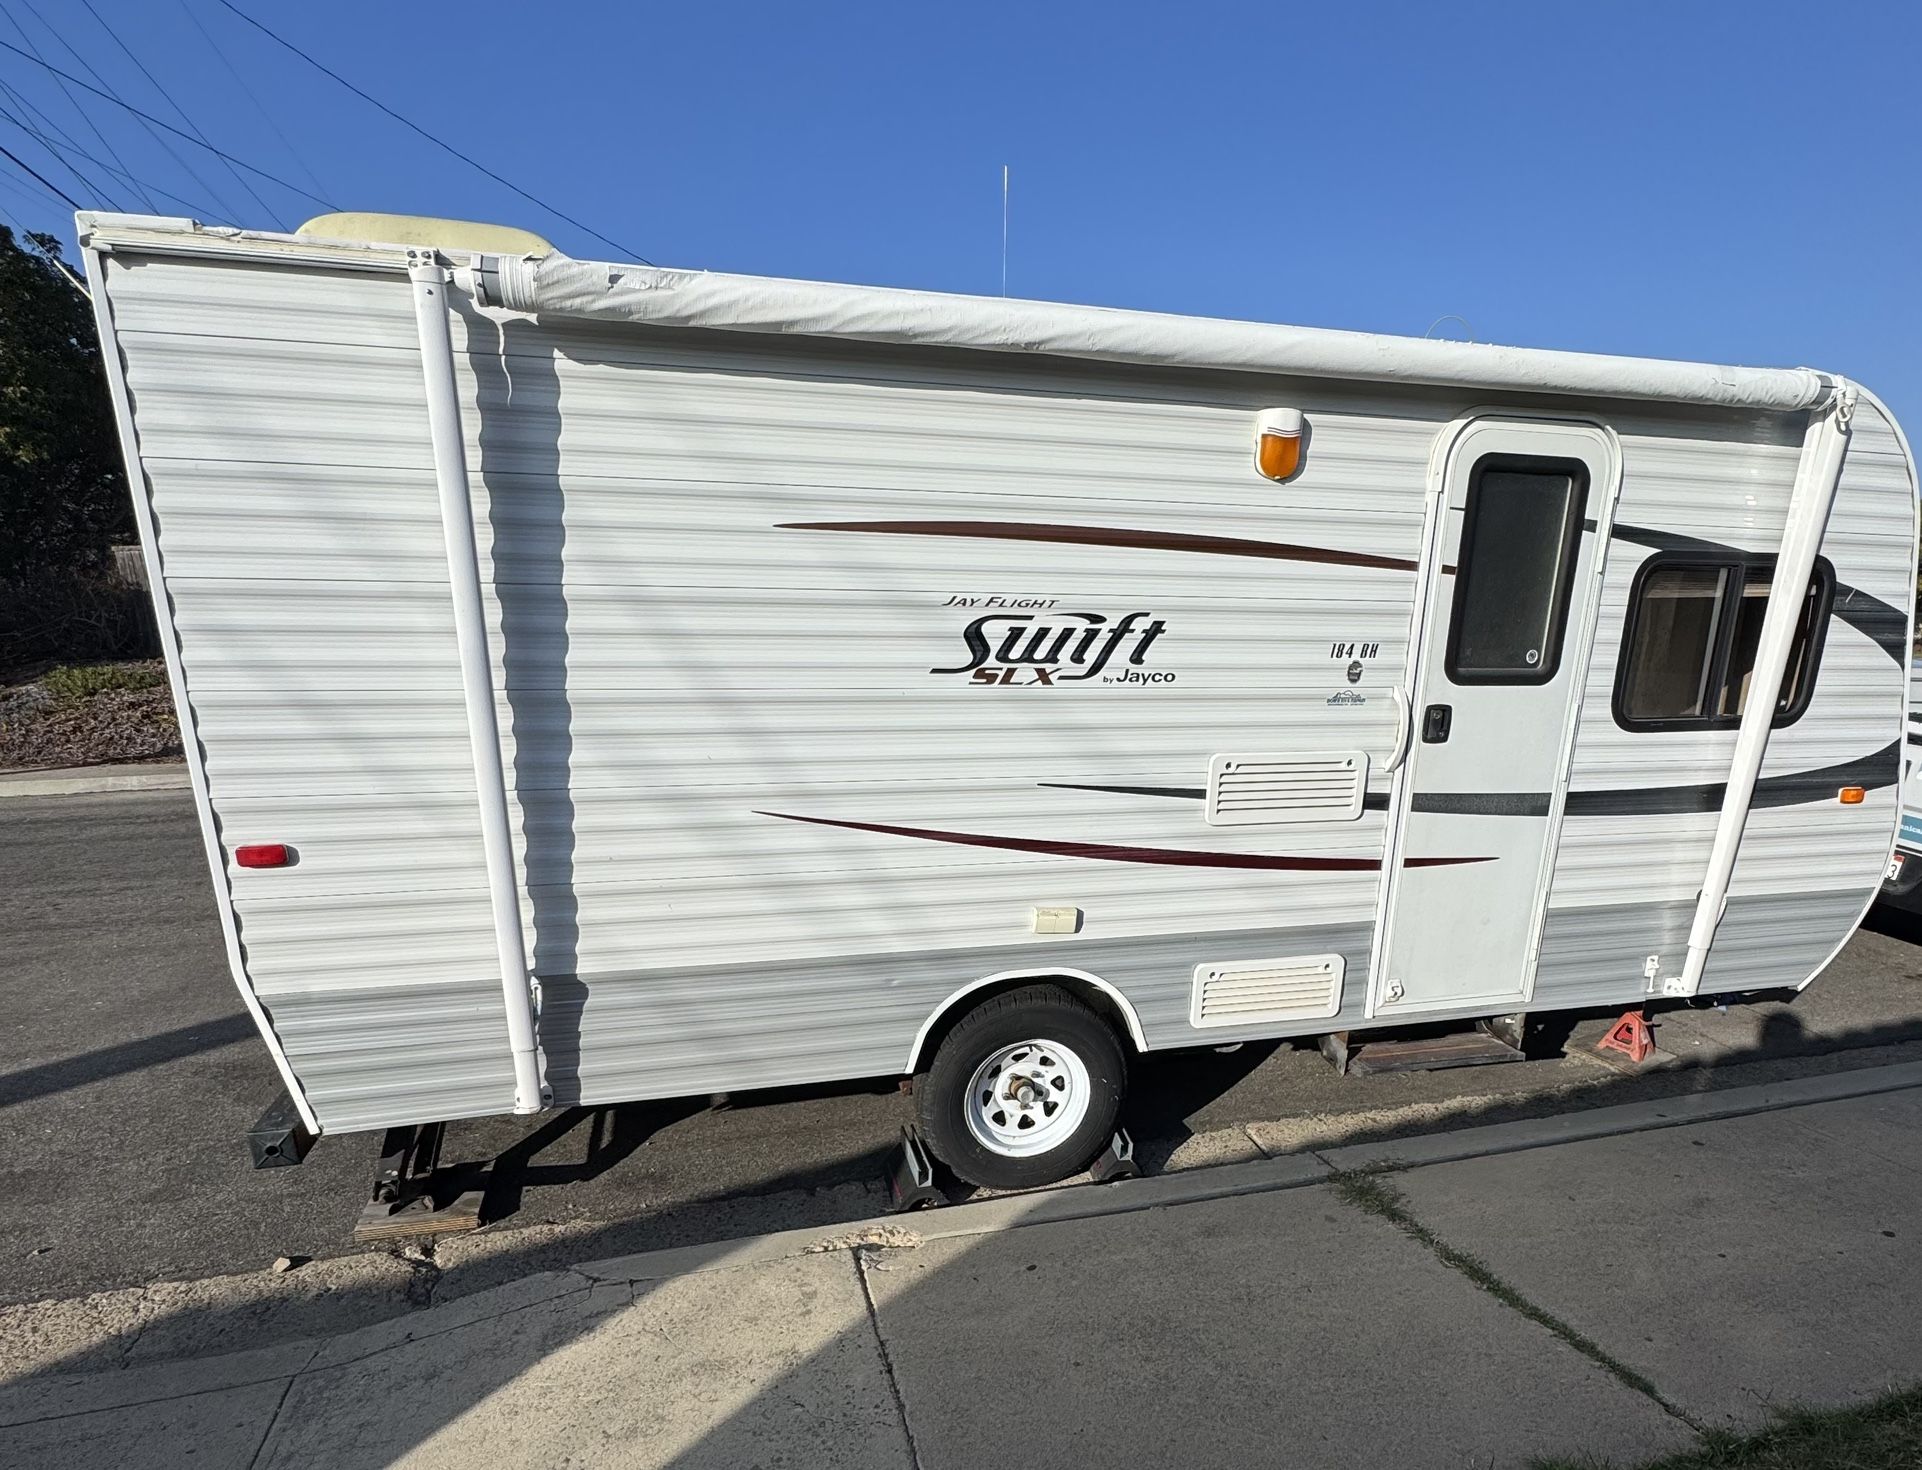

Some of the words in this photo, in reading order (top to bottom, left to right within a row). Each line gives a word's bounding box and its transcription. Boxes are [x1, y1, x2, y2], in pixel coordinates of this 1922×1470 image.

[941, 595, 981, 607] JAY
[984, 596, 1060, 609] FLIGHT
[929, 612, 1167, 680] Swift
[1330, 643, 1355, 658] 184
[1360, 643, 1379, 658] BH
[968, 667, 1063, 686] SLX
[1102, 674, 1114, 685] by
[1116, 668, 1176, 685] Jayco
